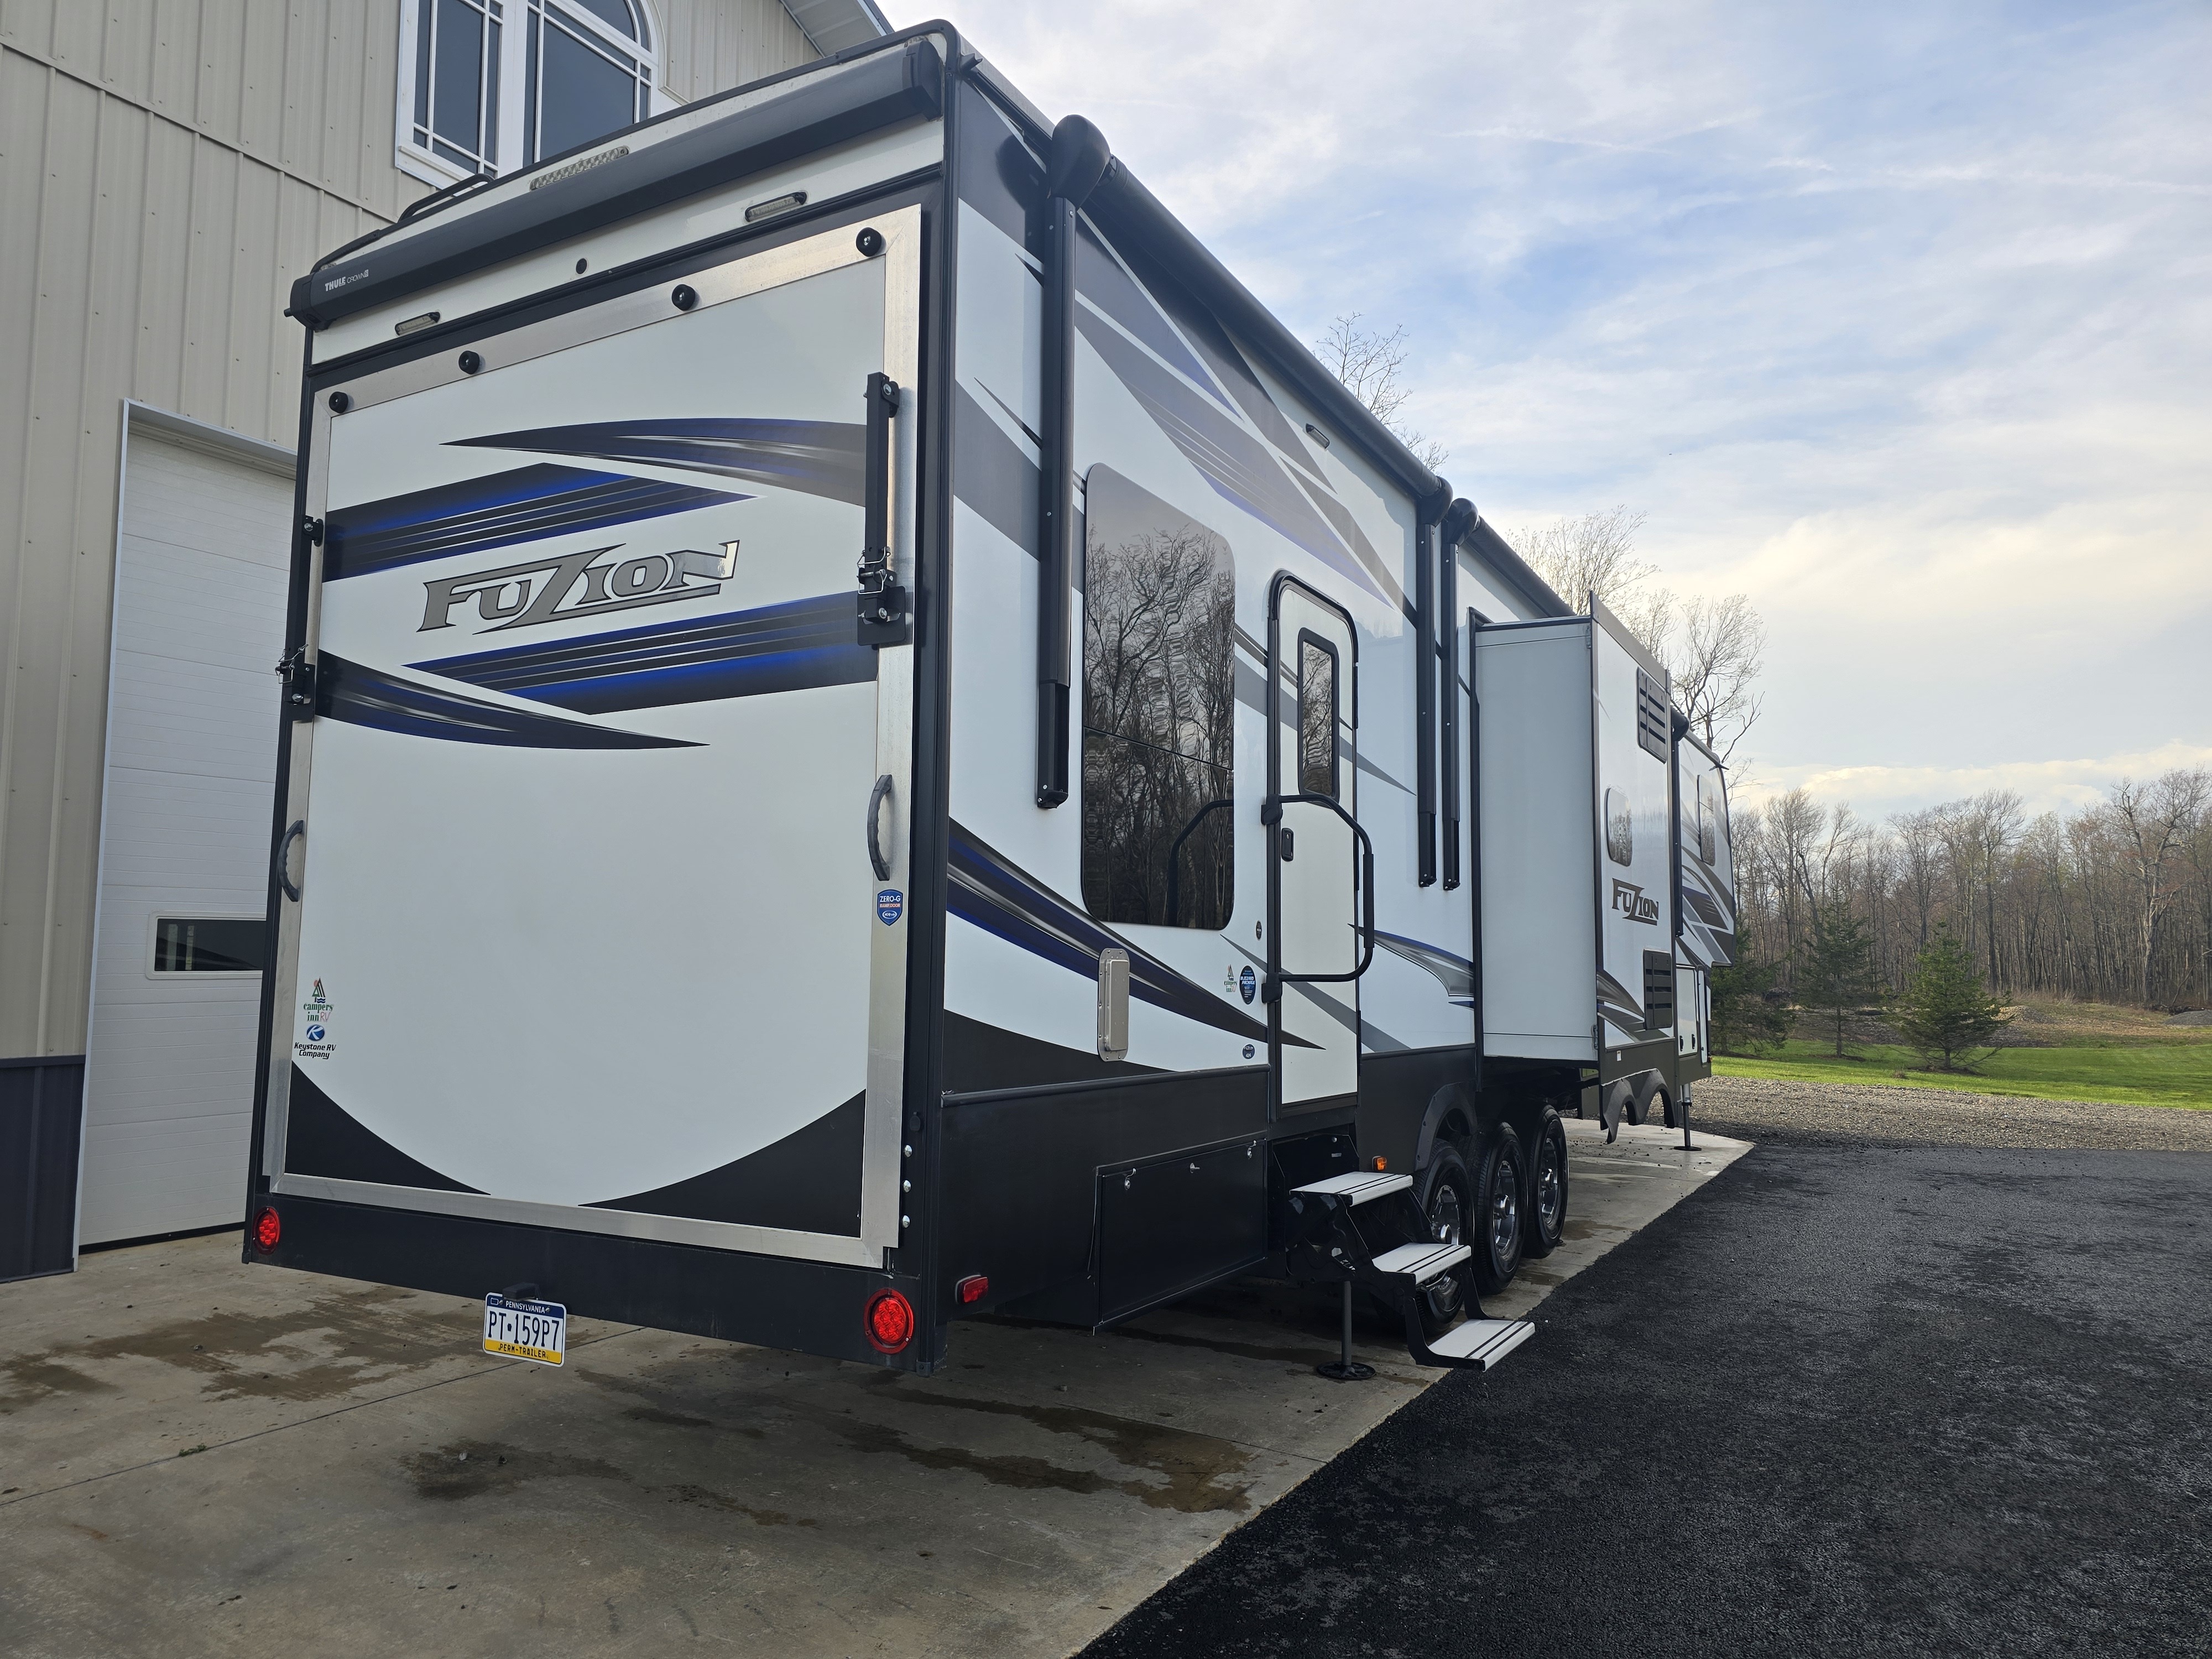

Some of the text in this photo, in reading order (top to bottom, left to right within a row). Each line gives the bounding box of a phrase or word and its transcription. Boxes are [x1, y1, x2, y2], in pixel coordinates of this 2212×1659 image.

[325, 276, 346, 291] THULE
[304, 1003, 333, 1013] campers
[307, 1011, 331, 1022] inn RV
[294, 1042, 326, 1051] Keystone
[299, 1049, 330, 1060] Company
[505, 1300, 545, 1313] PENNSYLVANIA
[499, 1343, 546, 1359] PERM-TRAILER
